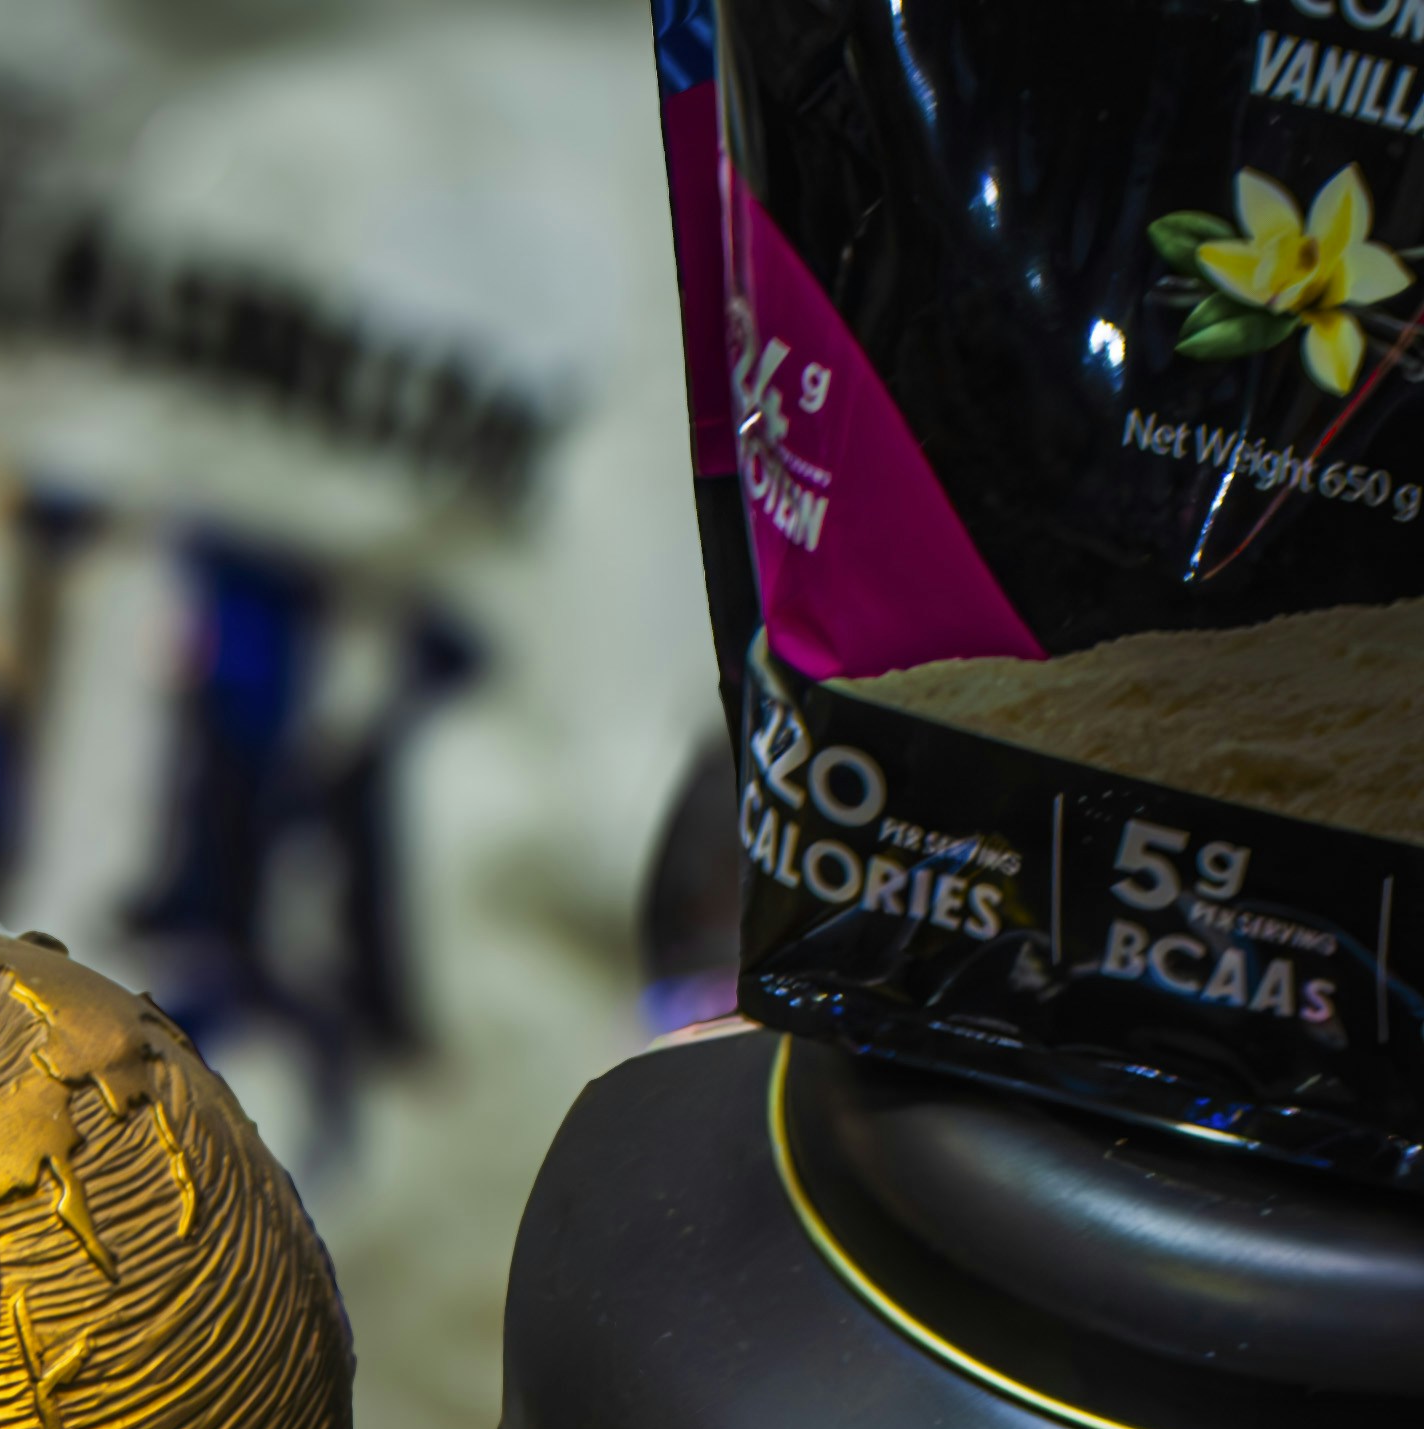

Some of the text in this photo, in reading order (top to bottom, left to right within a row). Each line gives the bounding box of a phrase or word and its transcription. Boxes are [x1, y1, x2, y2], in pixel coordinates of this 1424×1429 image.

[1122, 407, 1190, 460] Net
[1195, 423, 1318, 493] Weight
[1318, 461, 1391, 508] 650
[739, 780, 1004, 942] CALORIES
